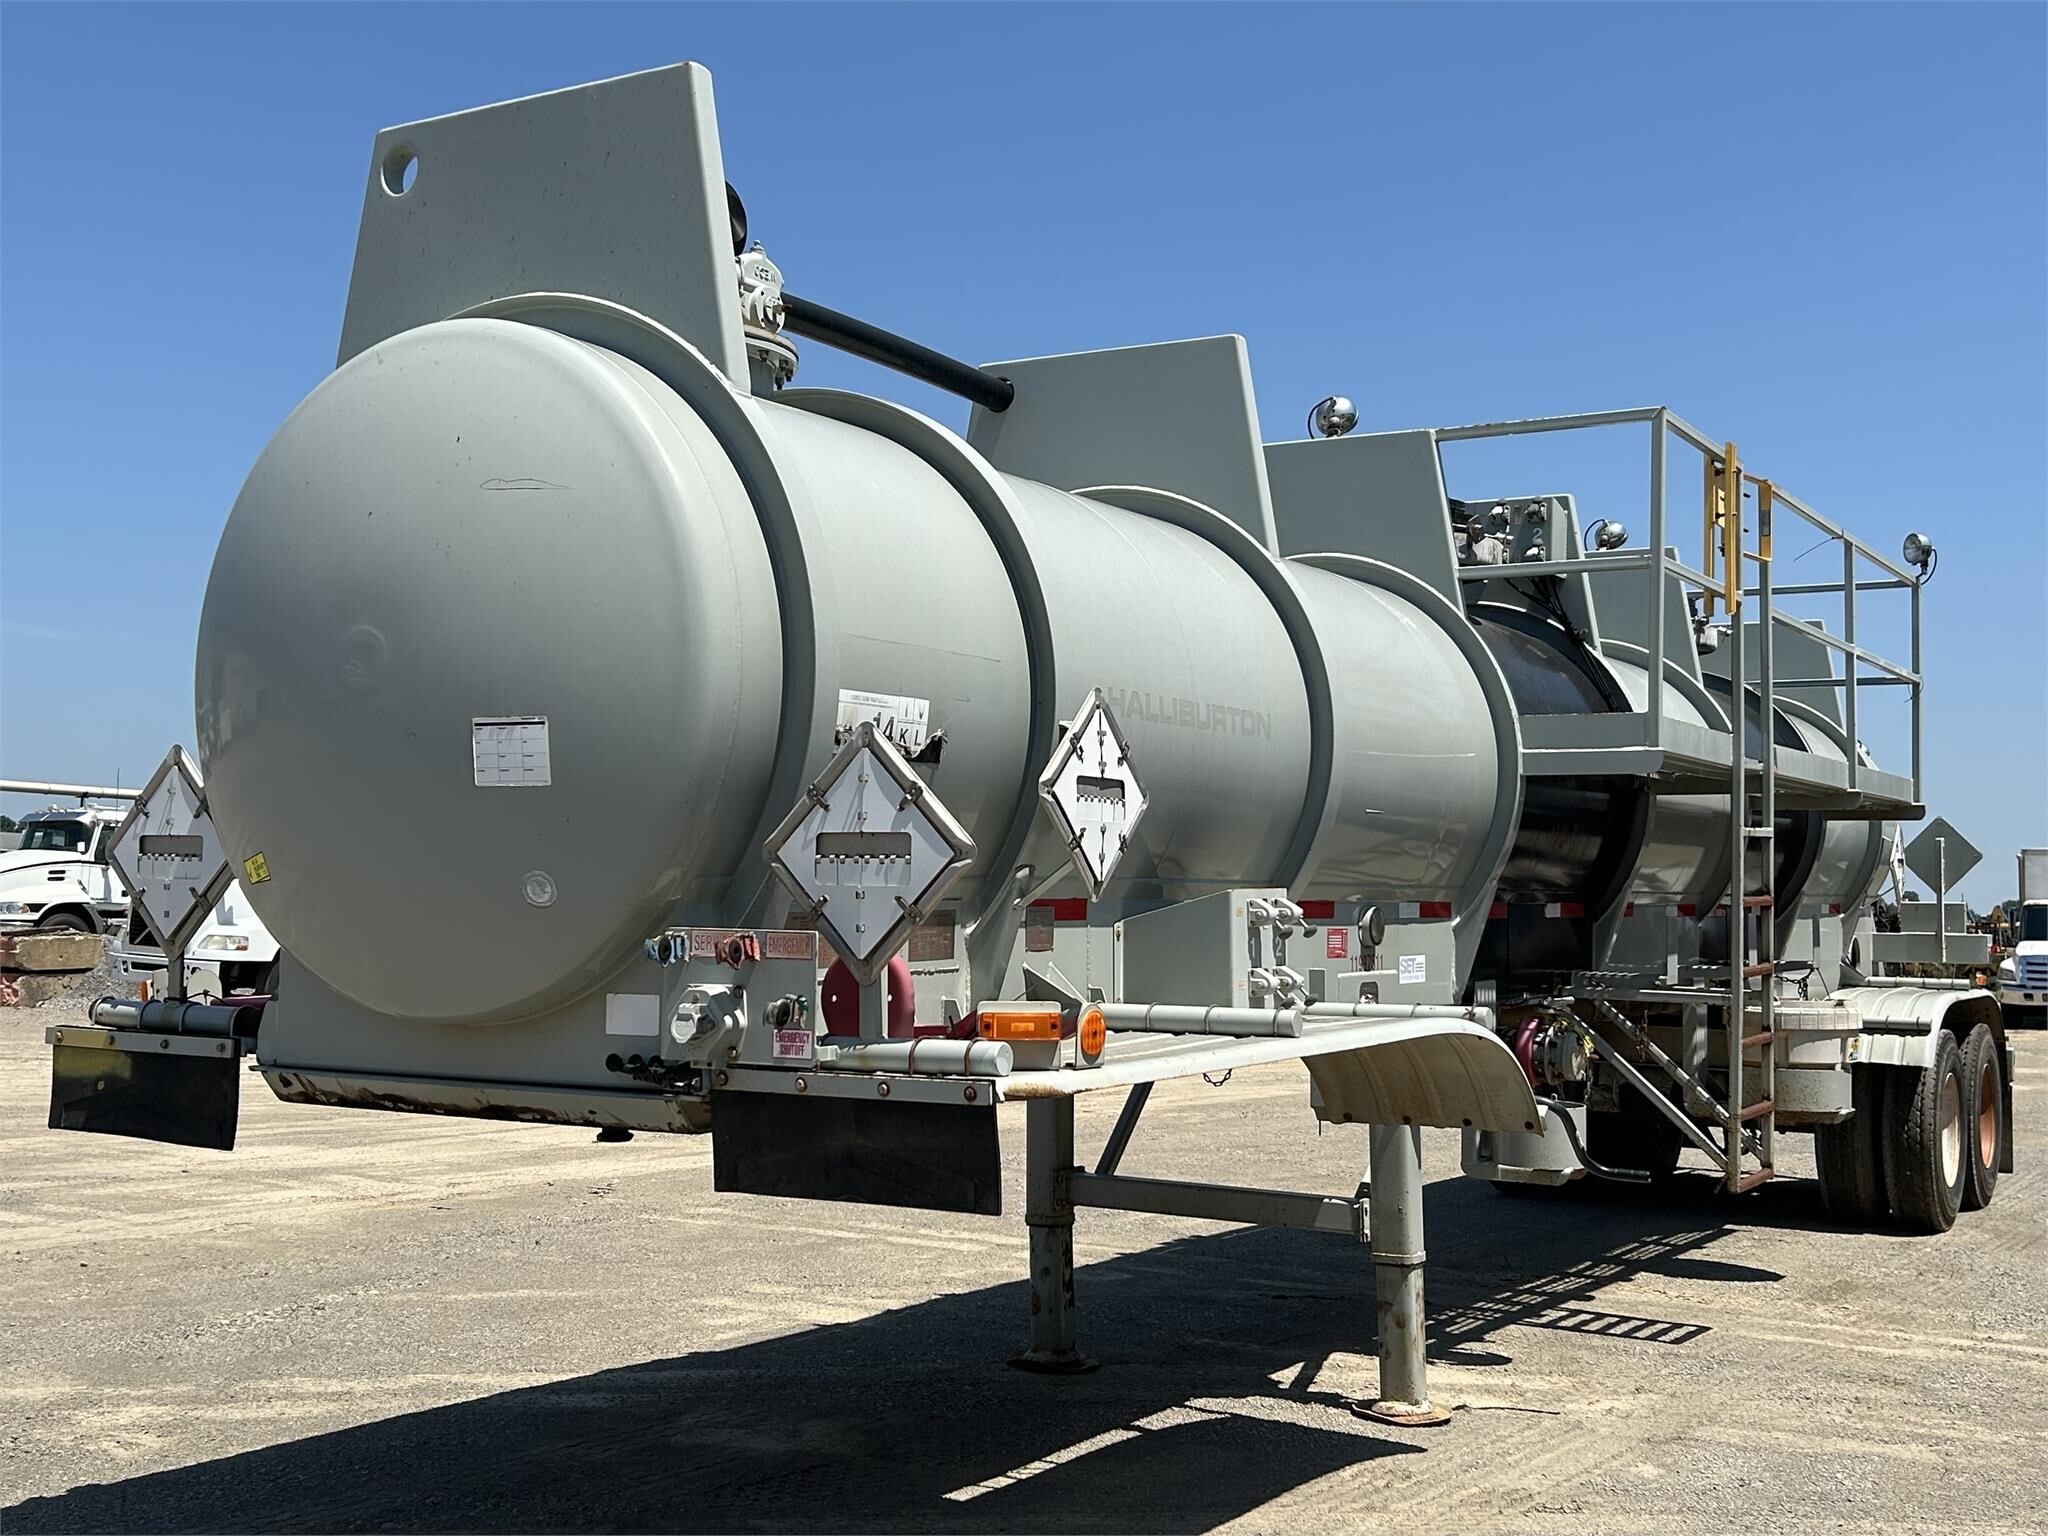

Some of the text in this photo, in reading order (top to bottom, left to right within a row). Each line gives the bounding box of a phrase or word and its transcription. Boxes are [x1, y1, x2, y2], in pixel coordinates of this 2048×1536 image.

[1106, 686, 1273, 740] HALLIBURTON
[768, 935, 811, 954] EMERGENCY
[1399, 956, 1417, 975] SET
[775, 1031, 811, 1044] EMERGENCY
